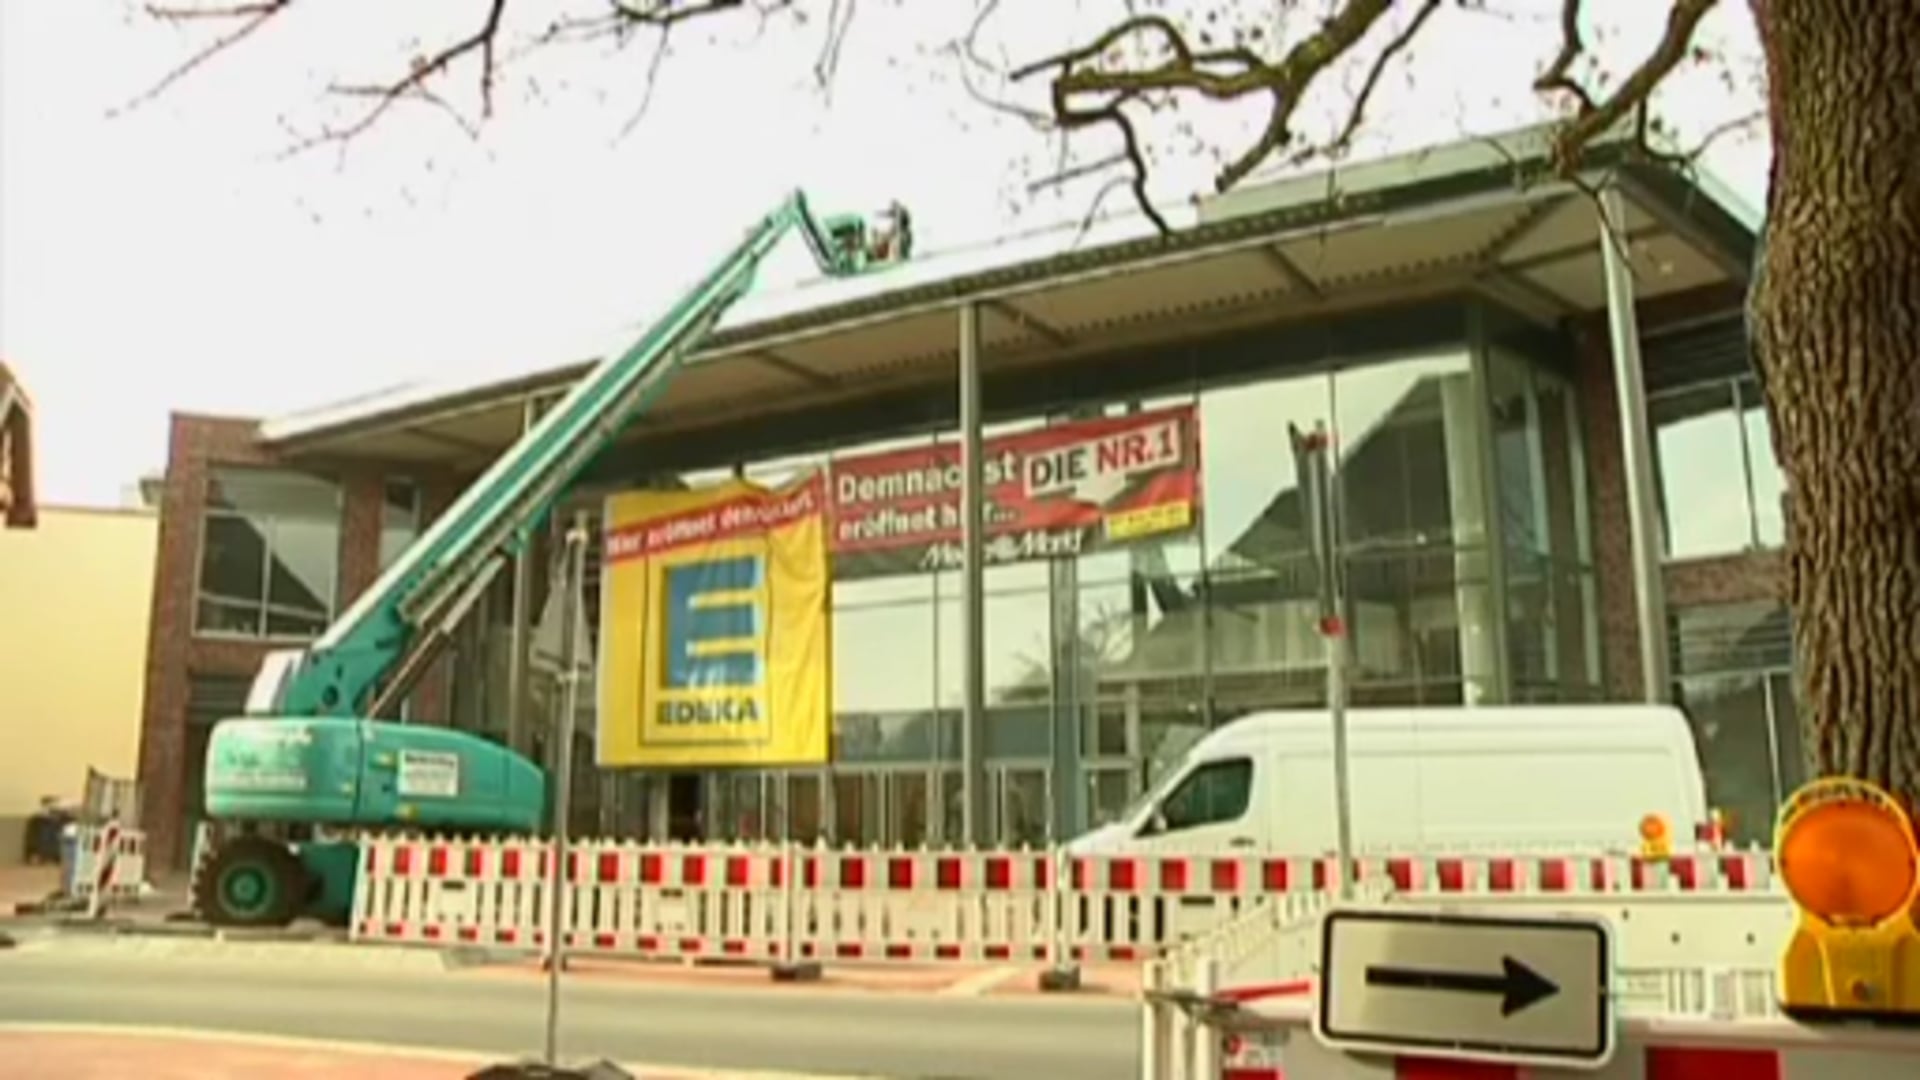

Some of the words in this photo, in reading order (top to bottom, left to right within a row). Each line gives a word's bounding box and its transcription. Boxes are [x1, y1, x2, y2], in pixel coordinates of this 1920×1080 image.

[838, 450, 1015, 504] Demnäcst
[1030, 448, 1086, 488] DIE
[1097, 426, 1174, 473] NR.1
[838, 504, 936, 541] eröffnet
[657, 696, 759, 725] EDEKA
